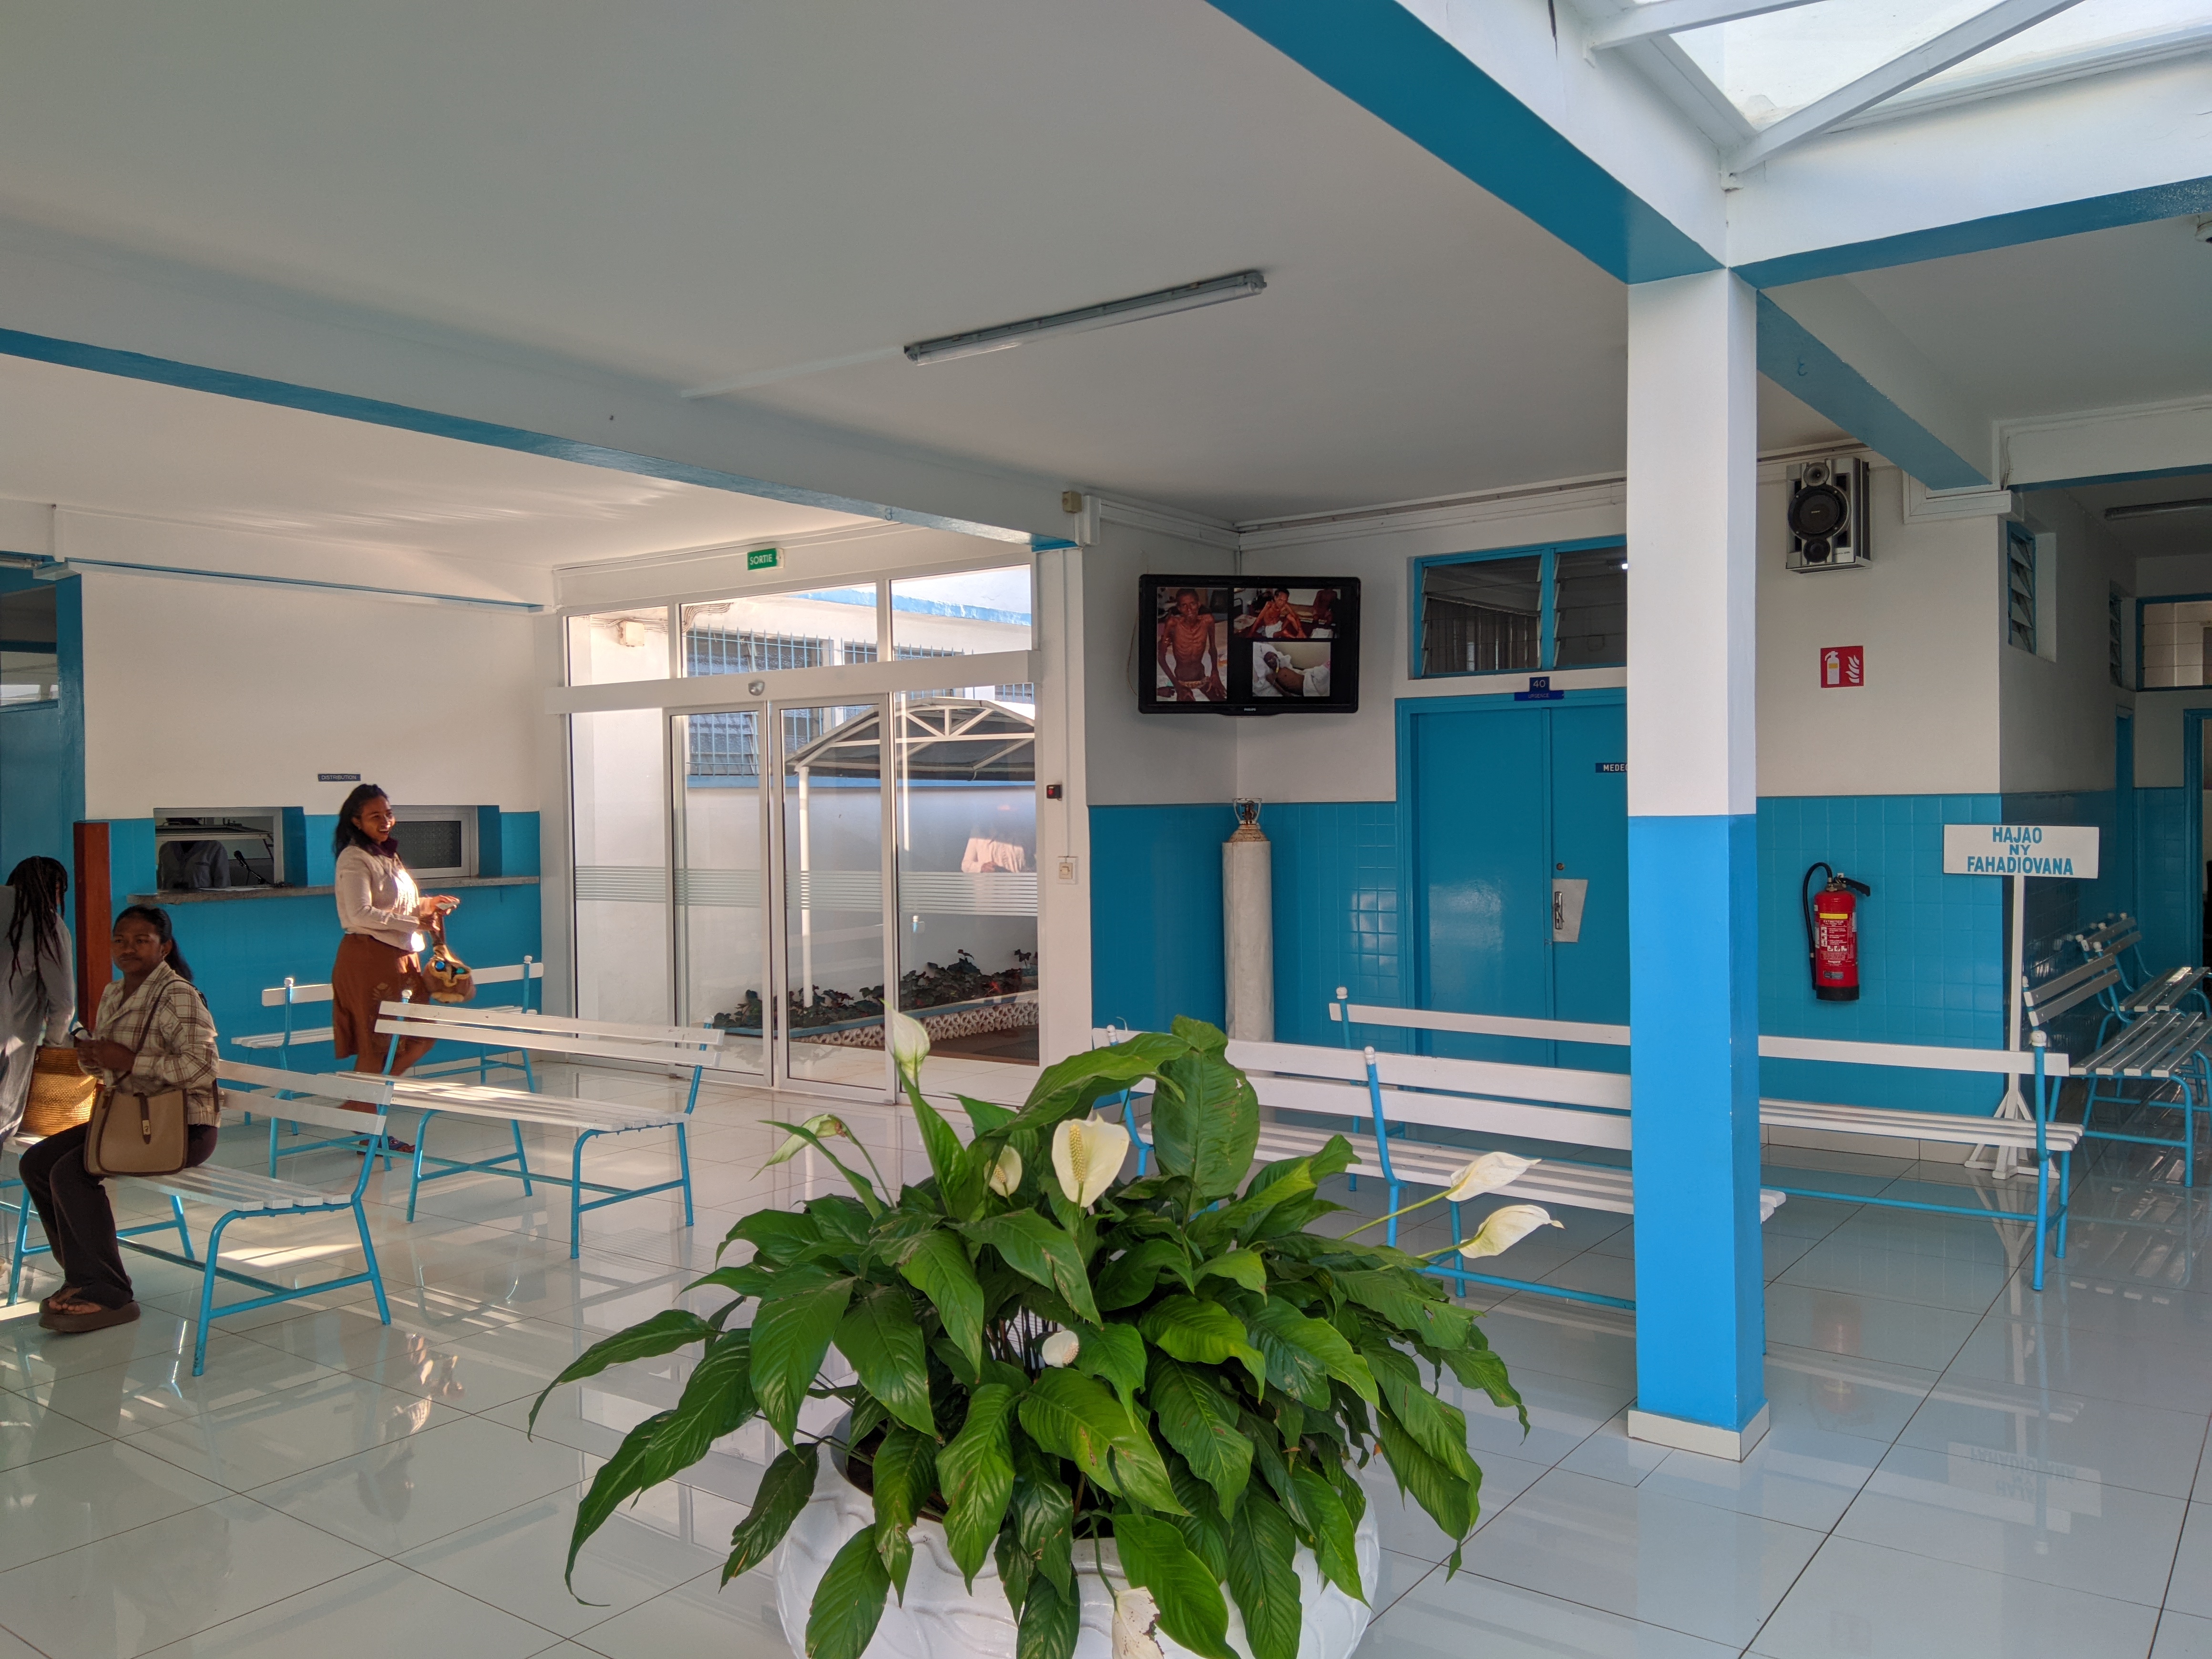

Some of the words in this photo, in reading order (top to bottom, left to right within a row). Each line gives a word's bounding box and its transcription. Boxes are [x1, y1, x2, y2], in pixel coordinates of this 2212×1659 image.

[750, 554, 772, 565] SORTIE
[1533, 679, 1546, 688] 40
[1992, 827, 2042, 844] HAJAO
[2009, 844, 2031, 855] NY
[1967, 856, 2074, 875] FAHADIOVANA
